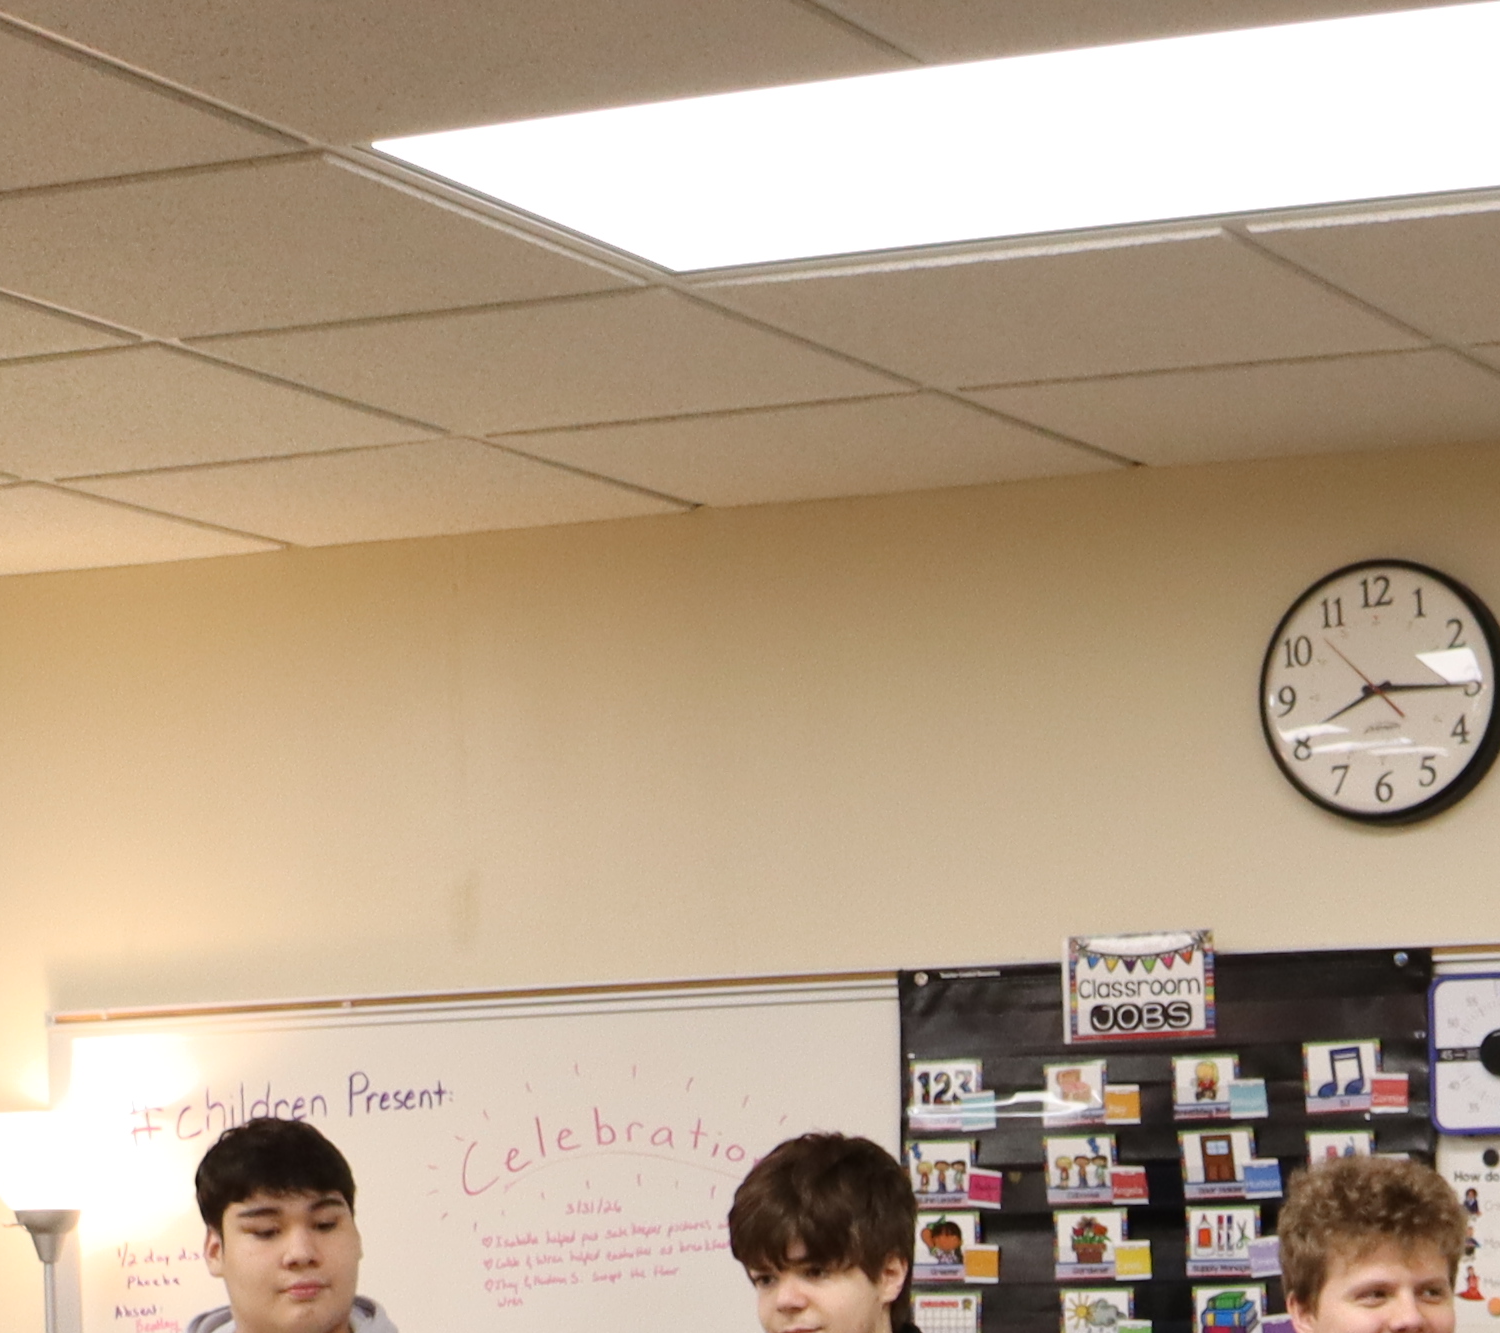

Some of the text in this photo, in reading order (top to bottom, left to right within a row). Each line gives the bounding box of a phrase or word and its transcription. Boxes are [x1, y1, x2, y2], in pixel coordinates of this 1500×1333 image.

[1360, 576, 1393, 609] 12
[1414, 588, 1426, 618] 1
[1321, 597, 1344, 628] 11
[1446, 618, 1467, 649] 2
[1284, 635, 1312, 668] 10
[1277, 686, 1296, 717] 9
[1450, 714, 1470, 744] 4
[1293, 732, 1313, 760] 8
[1331, 765, 1350, 795] 7
[1375, 771, 1393, 802] 6
[1418, 755, 1437, 787] 5
[1078, 977, 1201, 999] Classroom
[1092, 1003, 1192, 1031] JOBS
[349, 1071, 453, 1118] Present:
[462, 1107, 758, 1196] Celebratio
[1454, 1172, 1480, 1183] How
[1484, 1171, 1500, 1182] do
[565, 1200, 622, 1215] 3/31/26
